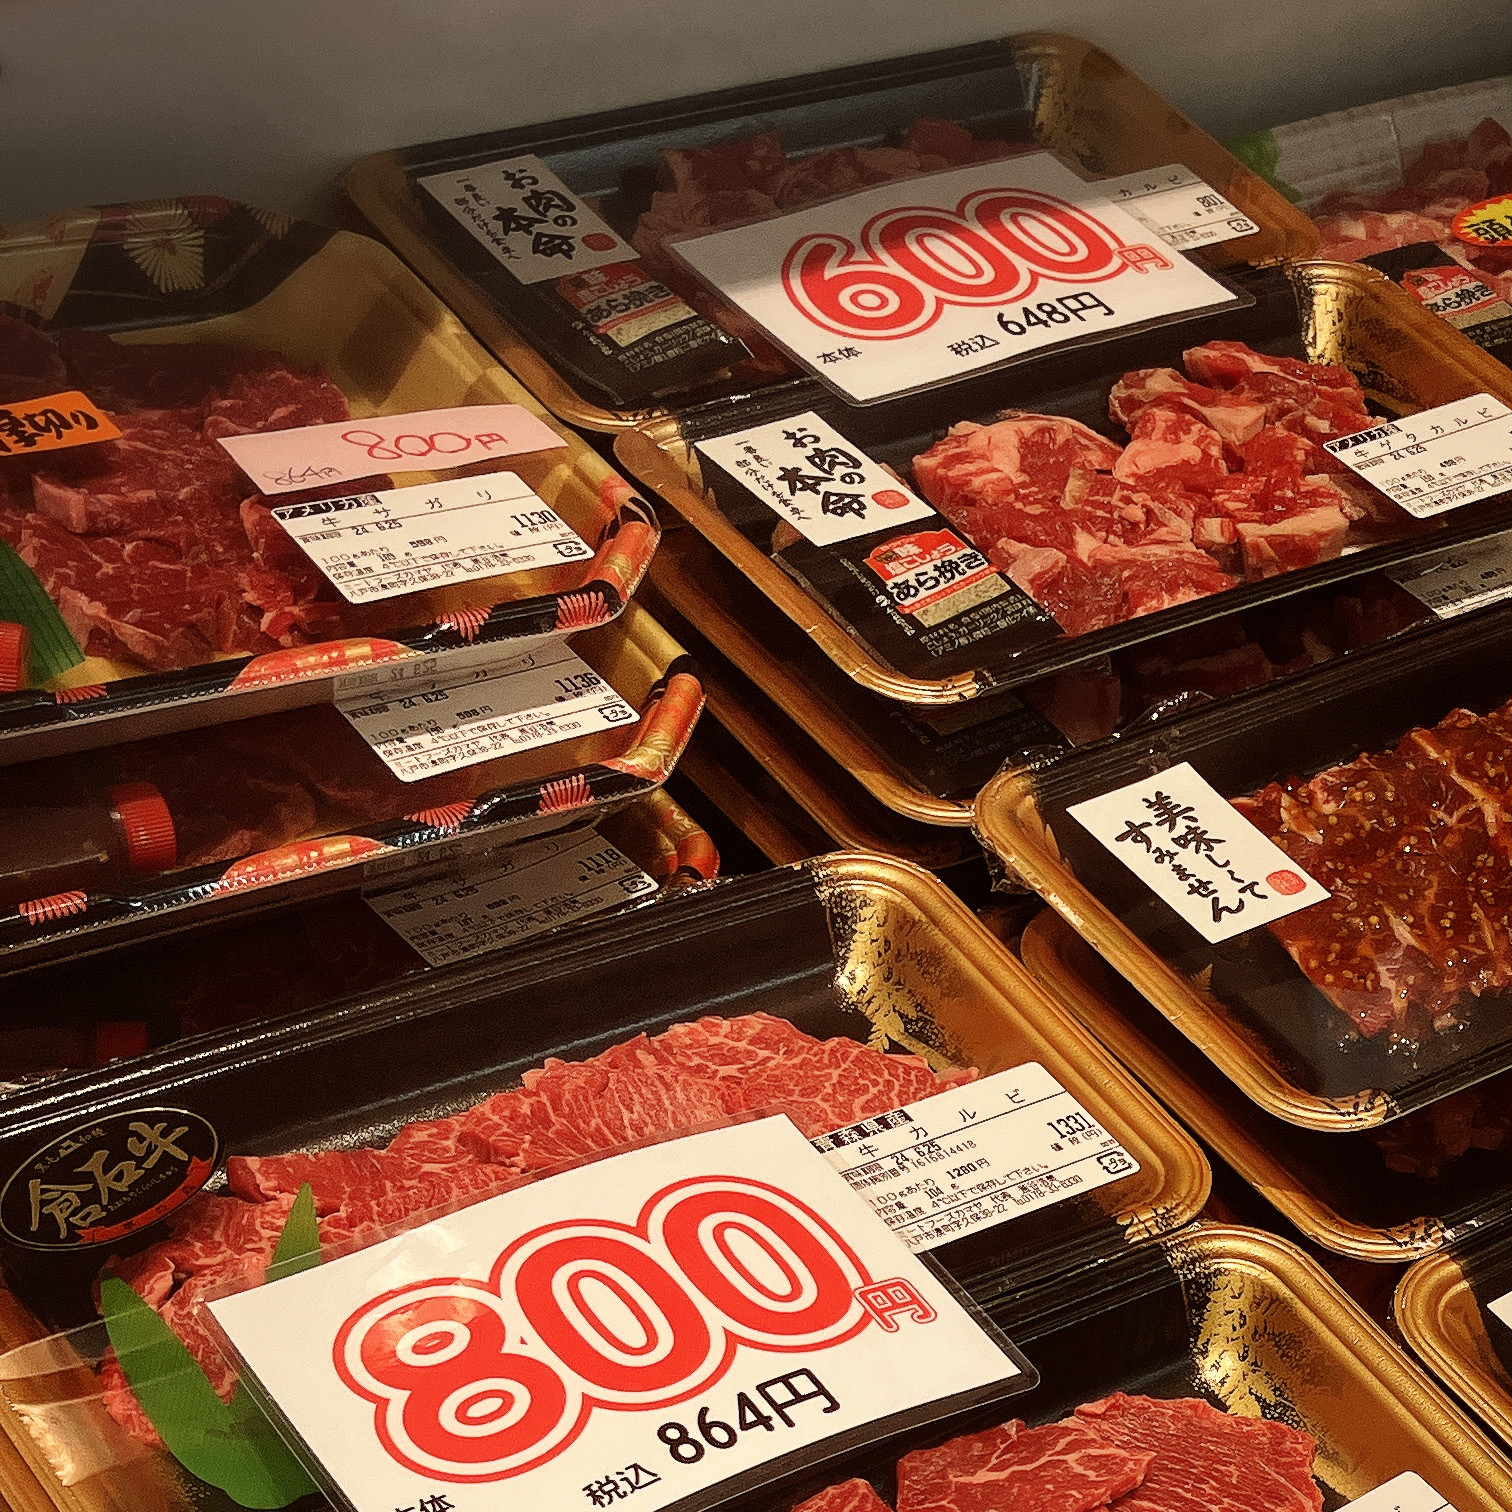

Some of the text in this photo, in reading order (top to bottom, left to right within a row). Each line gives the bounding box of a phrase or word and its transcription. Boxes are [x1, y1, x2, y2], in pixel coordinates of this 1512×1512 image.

[782, 187, 1174, 340] 600円
[948, 291, 1114, 358] 税込 648円
[816, 345, 863, 365] 本体
[342, 428, 508, 461] 800円
[510, 511, 558, 528] 1130
[887, 549, 986, 603] あら挽き
[555, 673, 600, 693] 1136
[860, 1088, 1025, 1158] 牛カルビ
[1048, 1113, 1093, 1139] 1331
[28, 1119, 192, 1240] 倉石牛
[947, 1158, 990, 1180] 1280円
[333, 1174, 938, 1484] 800円
[580, 1368, 841, 1508] 税込 864円
